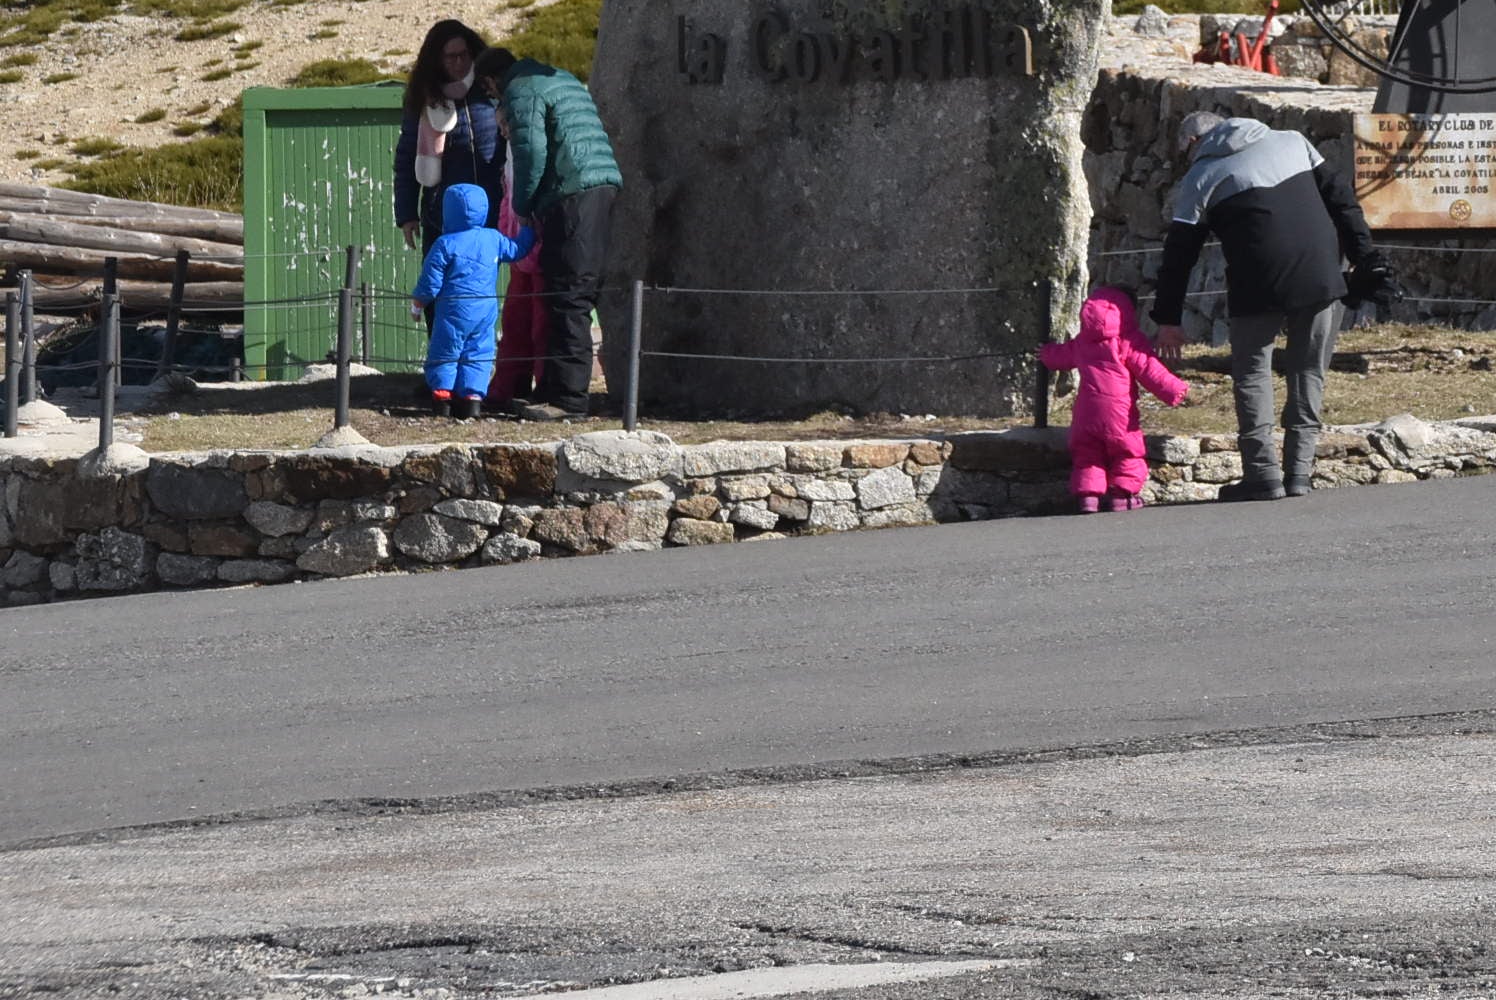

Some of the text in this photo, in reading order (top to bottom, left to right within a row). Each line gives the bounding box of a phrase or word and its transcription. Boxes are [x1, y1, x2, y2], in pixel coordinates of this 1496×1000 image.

[754, 6, 1038, 86] Covatilla
[1378, 120, 1394, 132] EL
[1397, 119, 1442, 131] ROTARY
[1444, 119, 1476, 131] CLUB
[1479, 119, 1495, 130] DE
[1417, 141, 1465, 150] PERSONAS
[1468, 141, 1474, 149] E
[1418, 155, 1456, 164] POSIBLE
[1458, 155, 1471, 164] LA
[1432, 186, 1460, 195] ABRIL
